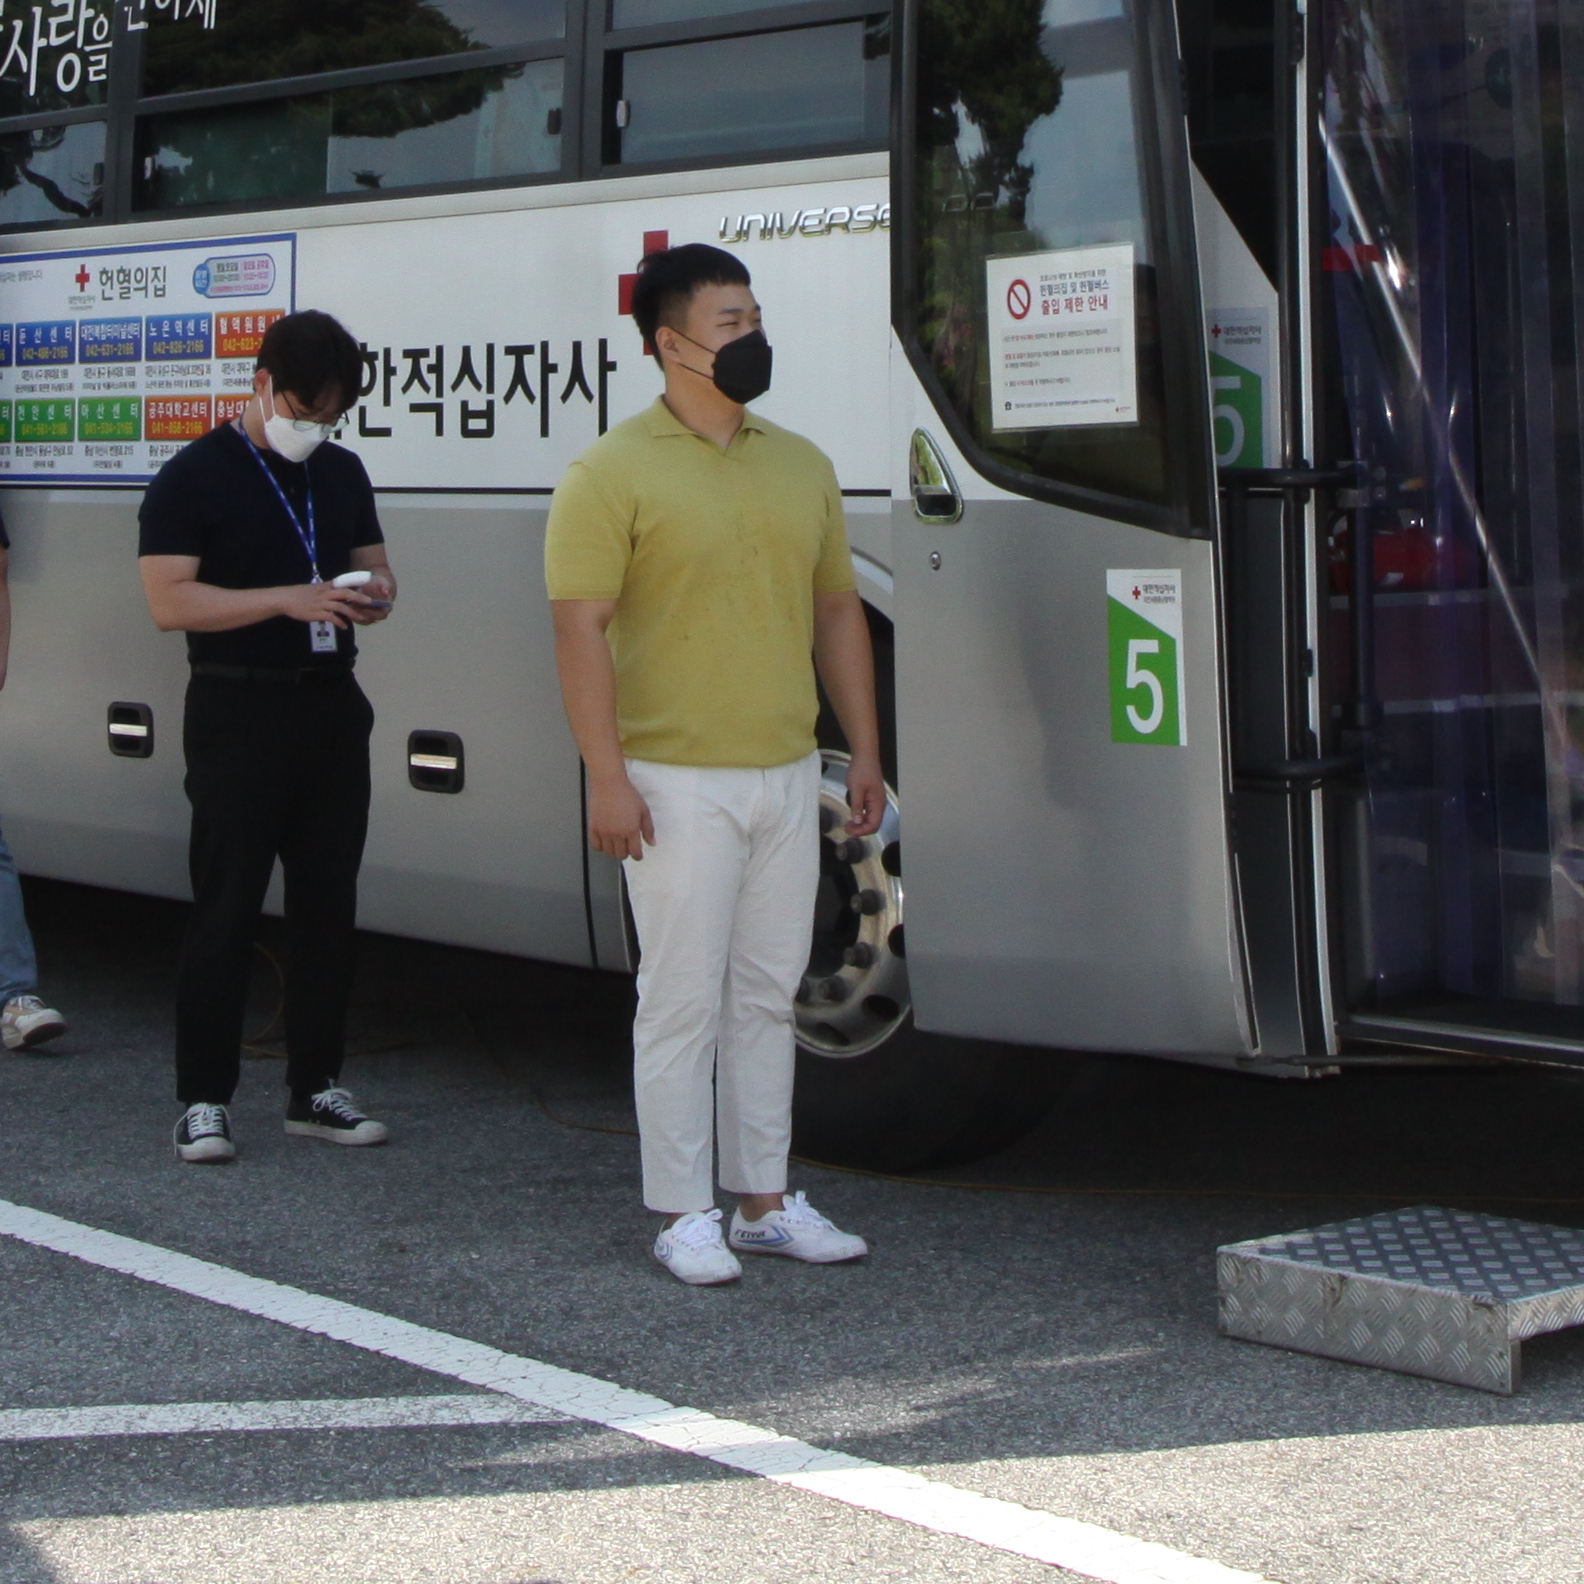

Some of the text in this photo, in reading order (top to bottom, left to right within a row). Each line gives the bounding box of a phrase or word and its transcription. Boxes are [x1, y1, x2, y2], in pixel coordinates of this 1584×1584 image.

[99, 266, 167, 301] 헌혈의집
[1040, 282, 1068, 296] 헌혈의집
[1080, 279, 1110, 292] 헌혈버스
[1042, 294, 1108, 315] 출입 제한 안내
[334, 338, 617, 440] 한적십자사
[149, 402, 206, 418] 공주대학교센터
[1211, 376, 1244, 467] 5
[1126, 640, 1163, 734] 5
